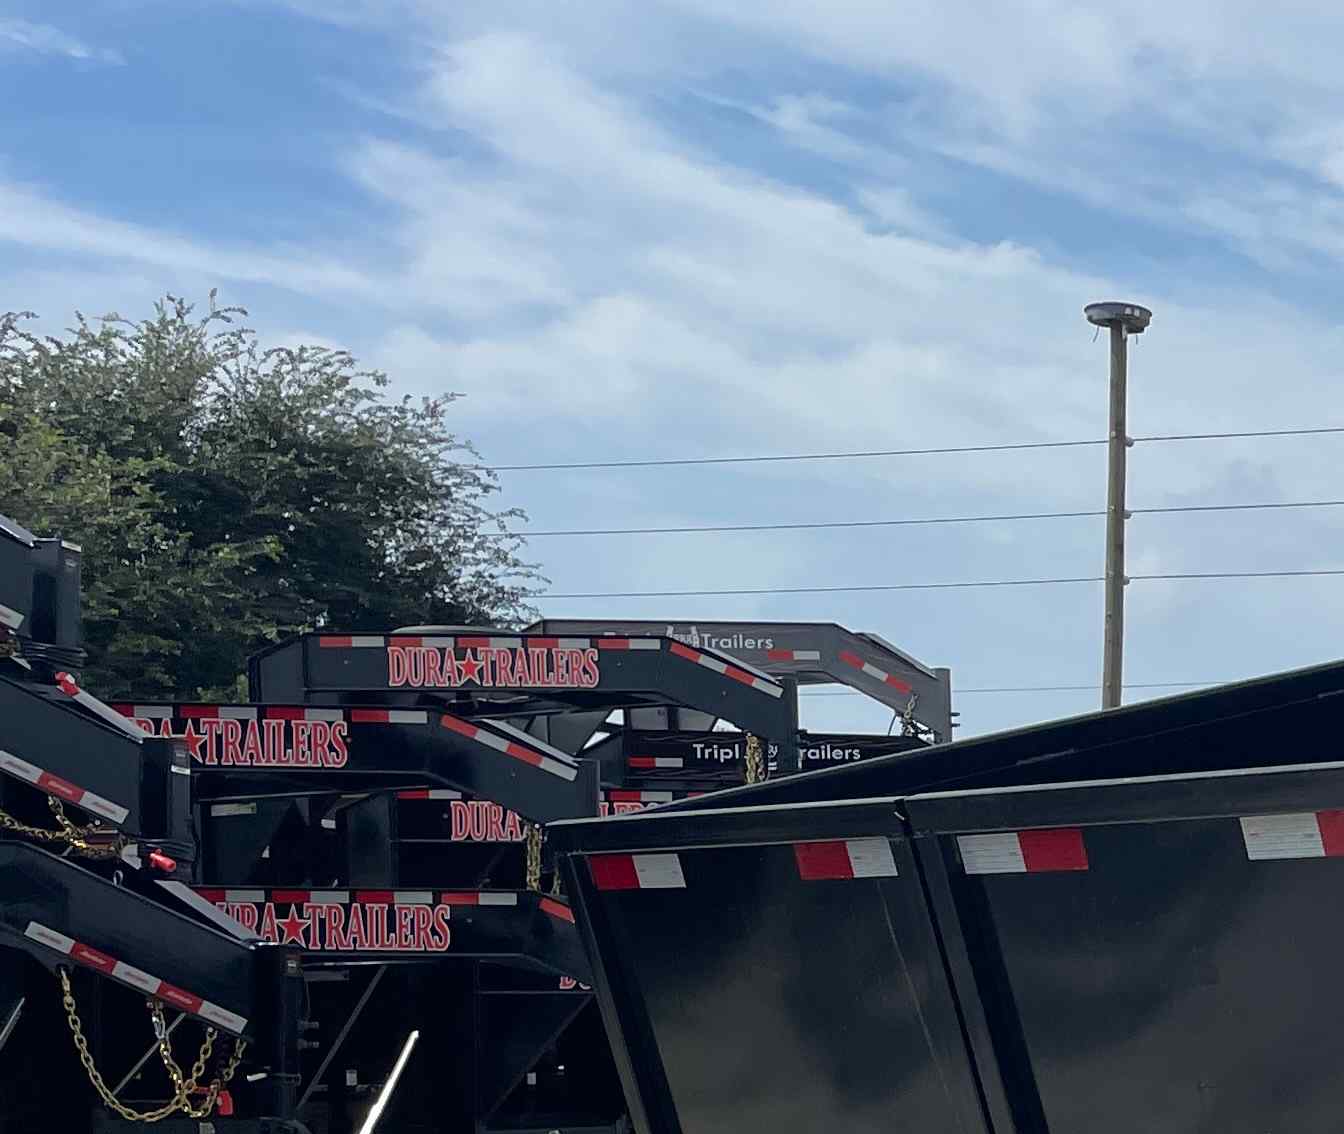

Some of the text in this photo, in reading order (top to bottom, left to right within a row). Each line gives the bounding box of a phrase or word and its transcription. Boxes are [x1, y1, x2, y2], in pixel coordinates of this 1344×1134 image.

[702, 633, 774, 649] Trailers
[387, 646, 600, 689] DURA TRAILERS
[201, 718, 348, 768] TRAILERS
[693, 744, 747, 762] Tripl
[799, 744, 861, 760] railers
[450, 801, 523, 841] DURA
[303, 903, 450, 951] TRAILERS
